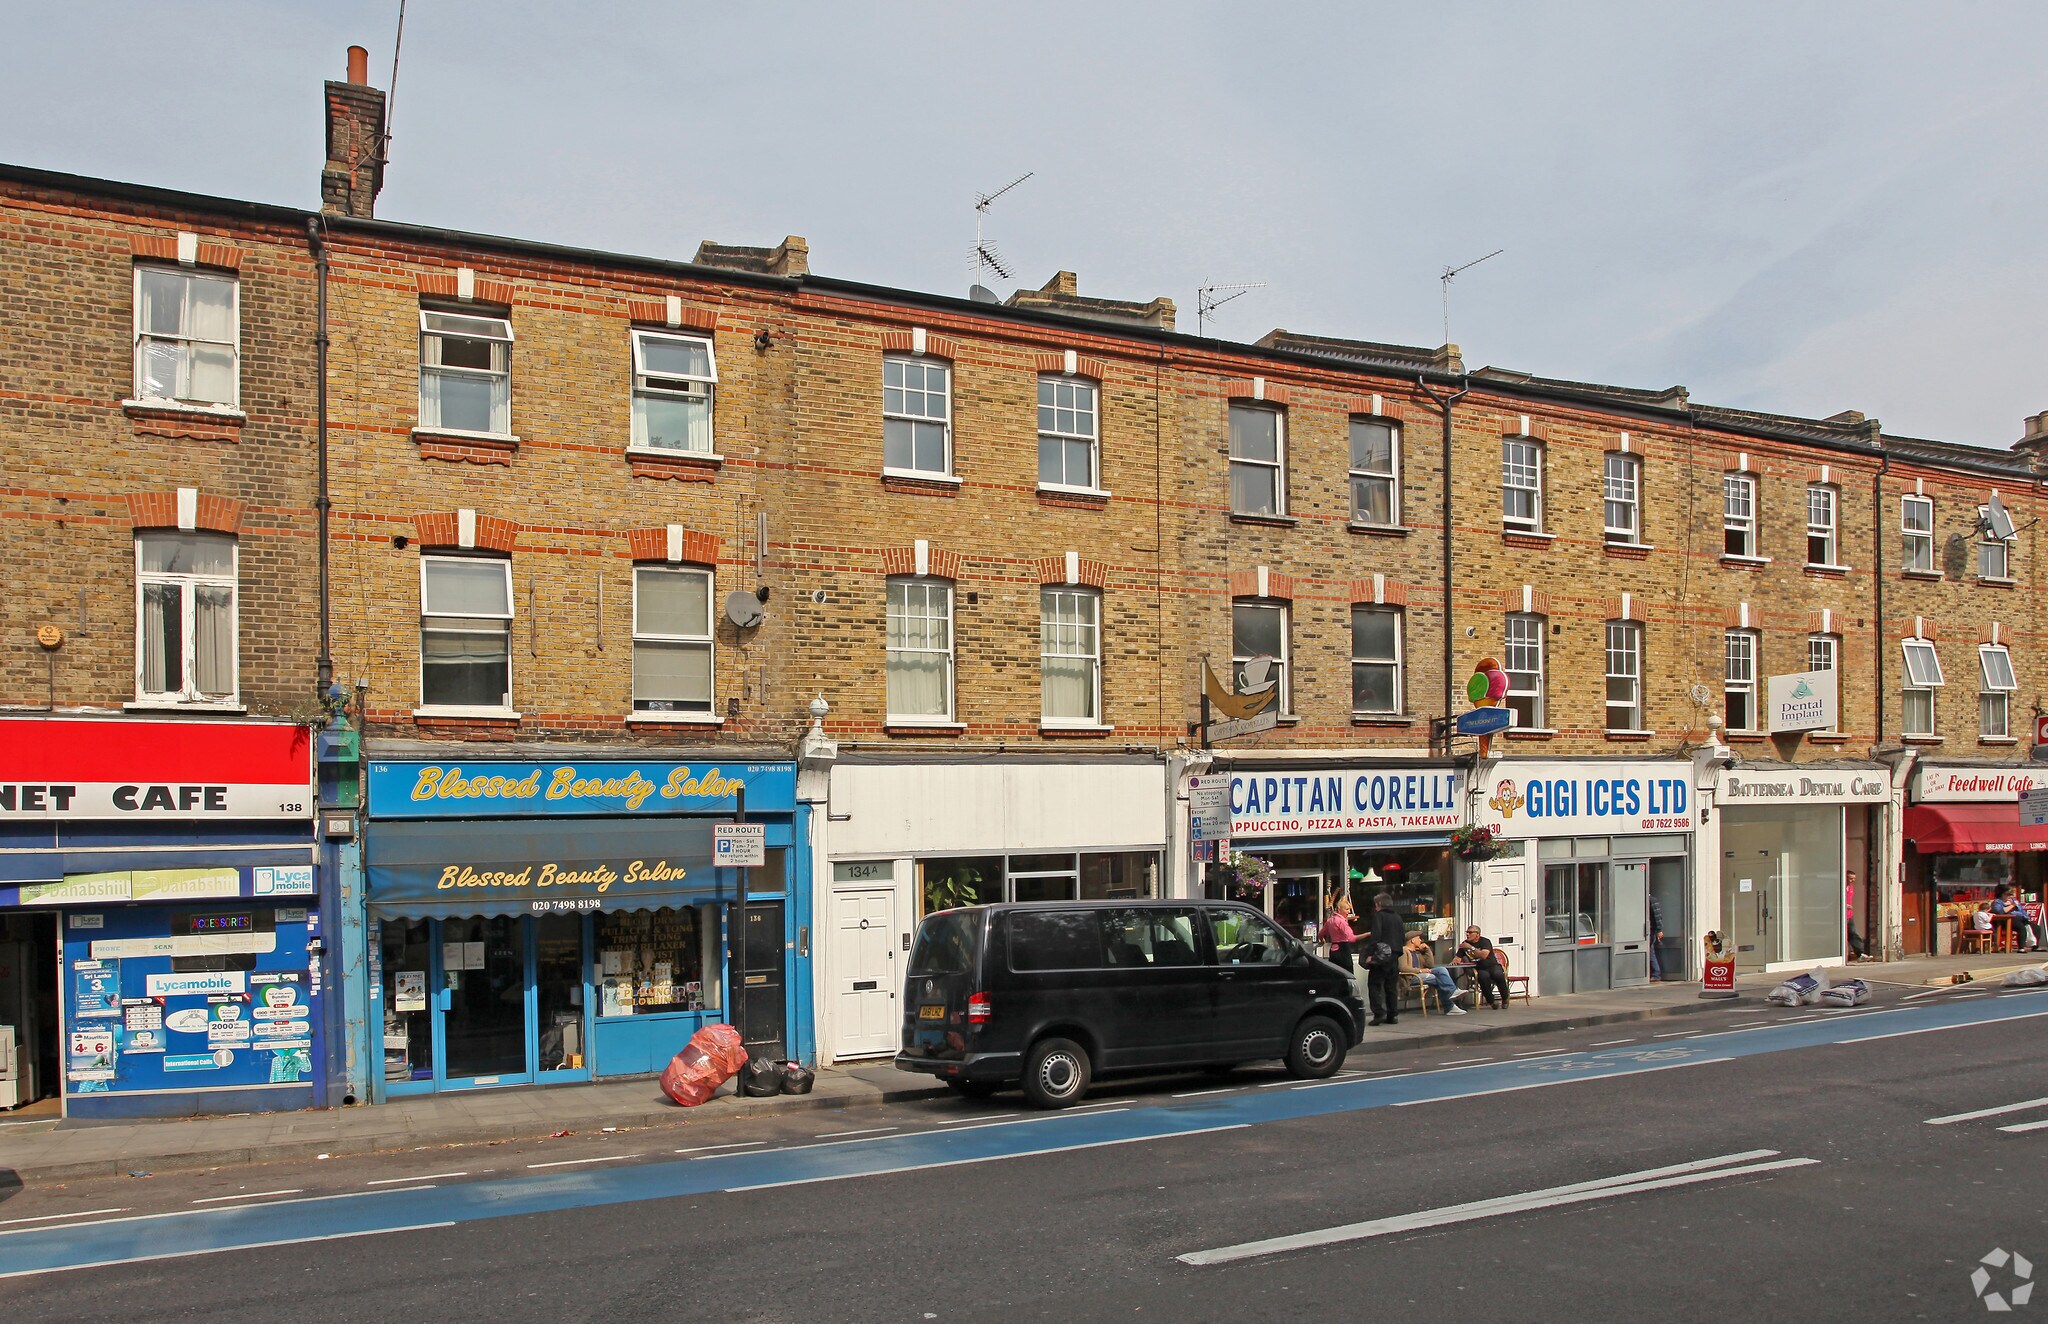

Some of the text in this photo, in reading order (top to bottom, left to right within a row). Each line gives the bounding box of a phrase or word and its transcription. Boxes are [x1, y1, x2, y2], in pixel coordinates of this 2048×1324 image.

[1782, 699, 1823, 712] Dental
[1782, 710, 1823, 721] Implant
[410, 766, 745, 810] Blessed Beauty Salon
[1728, 777, 1882, 797] BATTERSEA DENTAL CARE
[1948, 775, 2034, 792] Feedwell Cafe
[112, 785, 228, 811] CAFE
[1230, 776, 1455, 815] CAPITAN CORELLI
[1526, 779, 1687, 818] GIGI ICES LTD
[279, 804, 303, 812] 138
[1230, 815, 1460, 833] APPUCCINO, PIZZA & PASTA, TAKEAWAY
[1486, 824, 1501, 834] 130
[1642, 818, 1690, 829] 020 7622 9586
[276, 870, 311, 883] Lyca
[437, 860, 686, 892] Blessed Beauty Salon
[50, 880, 128, 897] Dahabshiil
[159, 873, 236, 894] Dahabshiil
[276, 881, 311, 889] mobile
[532, 899, 601, 911] 020 7498 8198
[612, 935, 638, 944] TRIM
[652, 933, 681, 941] TONG
[640, 940, 687, 950] RELAXER
[156, 978, 232, 991] Lycamobile
